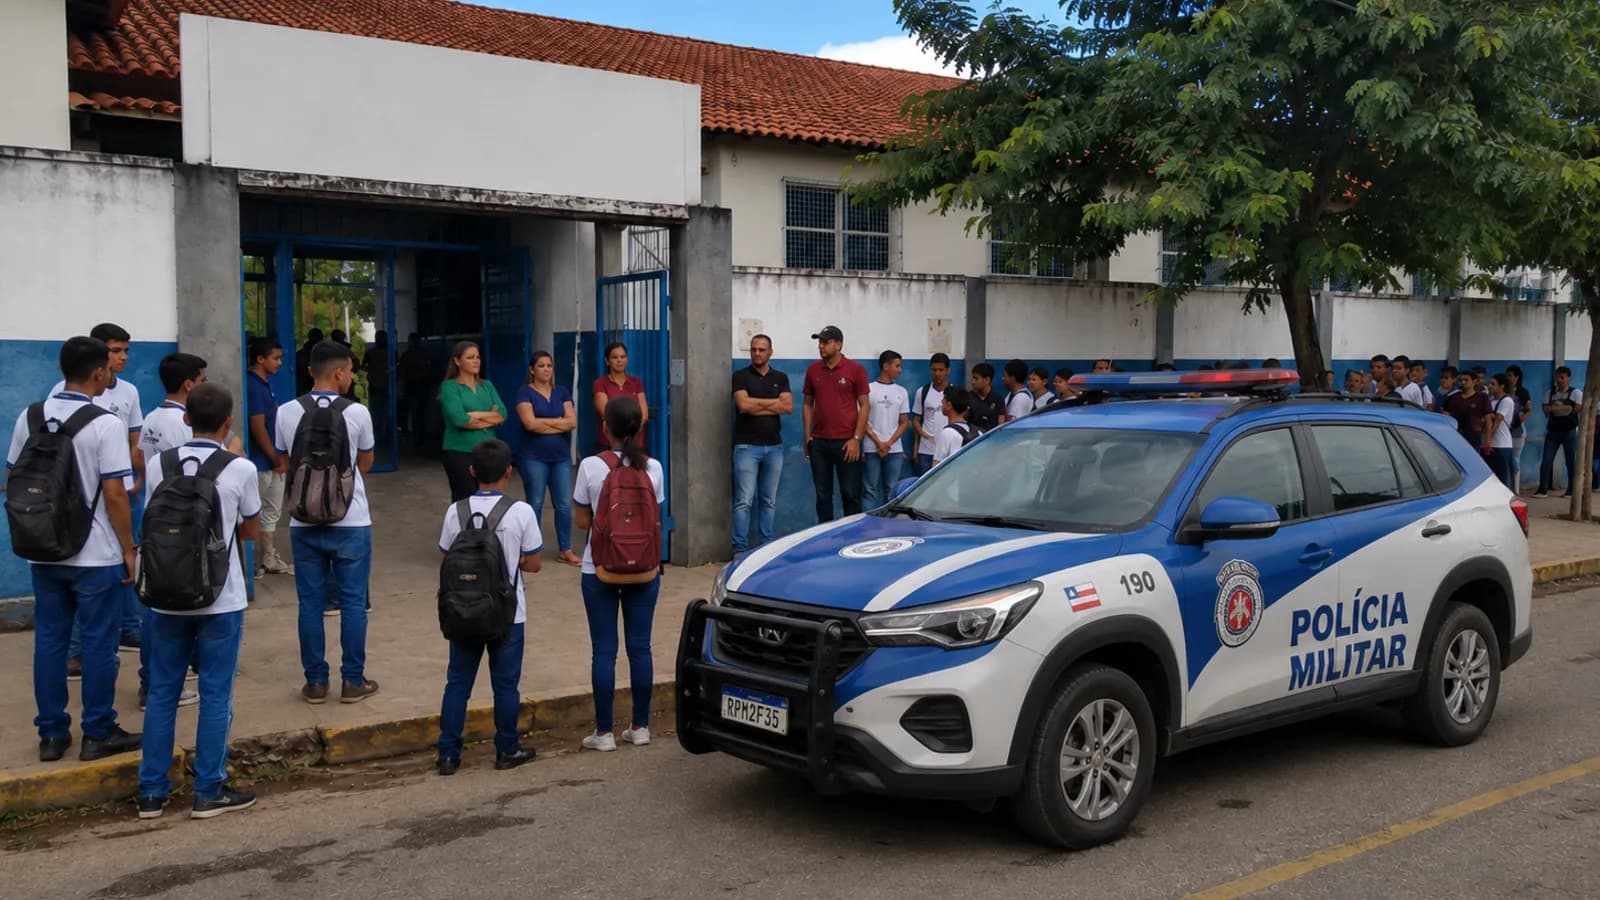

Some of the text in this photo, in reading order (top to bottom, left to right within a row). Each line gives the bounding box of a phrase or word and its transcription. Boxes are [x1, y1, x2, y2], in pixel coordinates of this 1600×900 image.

[1120, 571, 1155, 595] 190
[1290, 587, 1408, 647] POLÍCIA
[1288, 634, 1407, 691] MILITAR
[727, 697, 779, 729] RPM2F35
